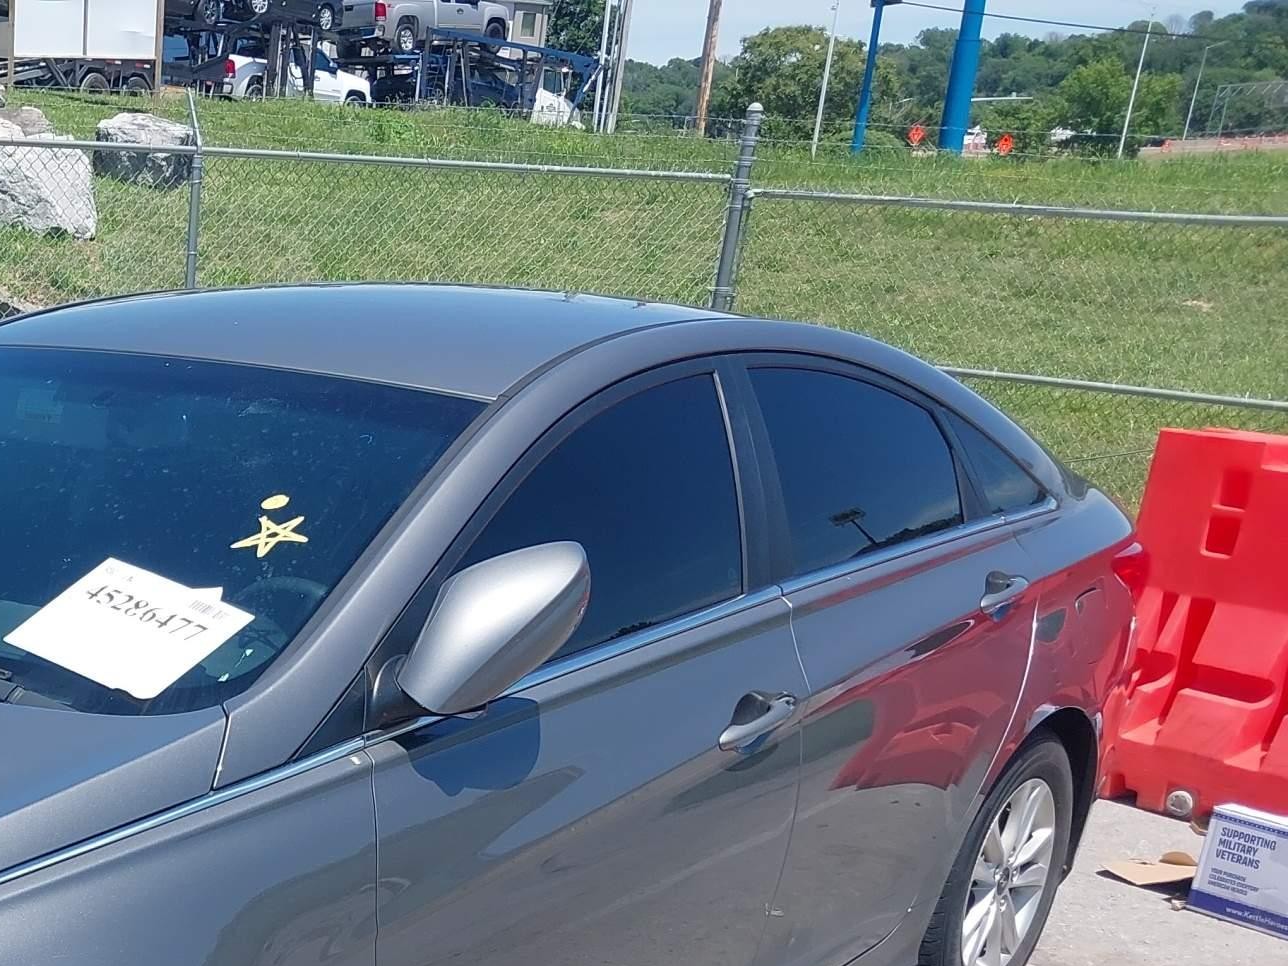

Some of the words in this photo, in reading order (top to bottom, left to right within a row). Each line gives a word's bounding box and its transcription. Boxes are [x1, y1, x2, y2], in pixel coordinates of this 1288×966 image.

[85, 585, 209, 641] 45286477
[1218, 838, 1259, 857] MILITARY
[1221, 827, 1277, 851] SUPPORTING
[1216, 848, 1261, 869] VETERANS
